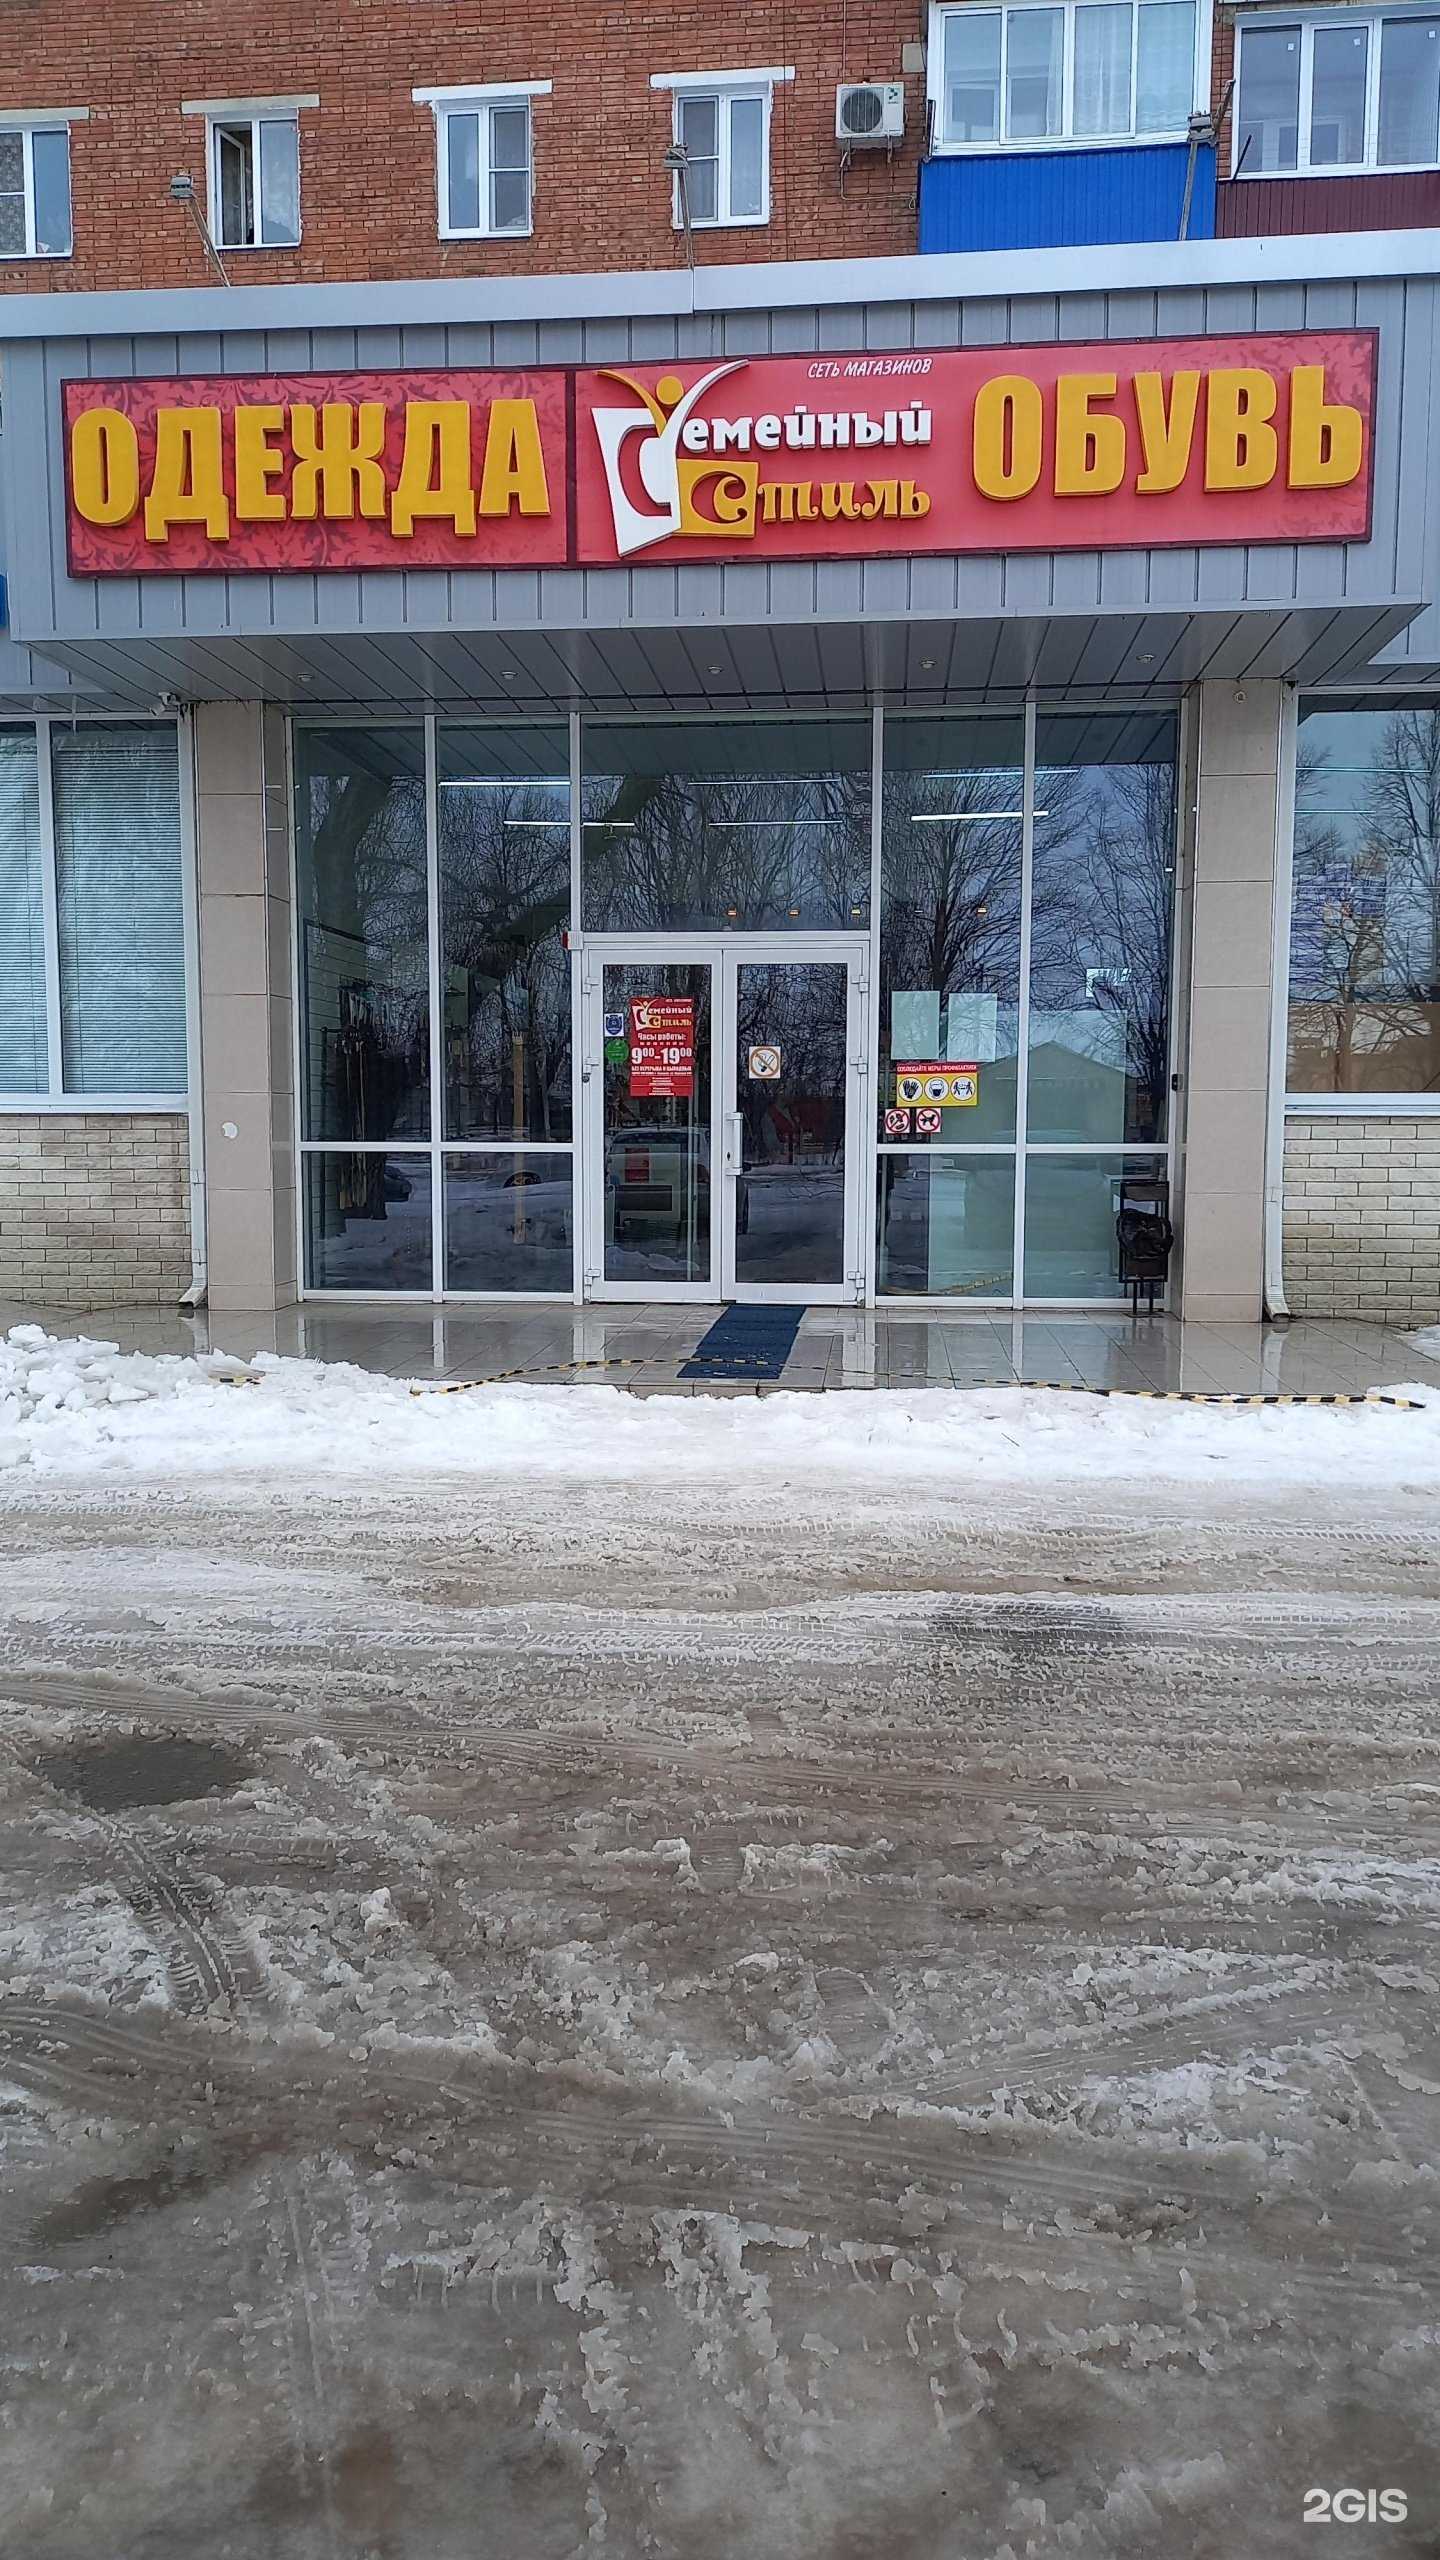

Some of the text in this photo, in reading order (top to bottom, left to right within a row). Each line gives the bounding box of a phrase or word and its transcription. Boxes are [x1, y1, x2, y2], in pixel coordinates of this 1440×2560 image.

[808, 357, 933, 379] СЕТЬ МАГАЗИНОВ
[71, 397, 551, 543] ОДЕЖДА
[972, 364, 1364, 501] ОБУВЬ
[680, 462, 933, 532] Стиль
